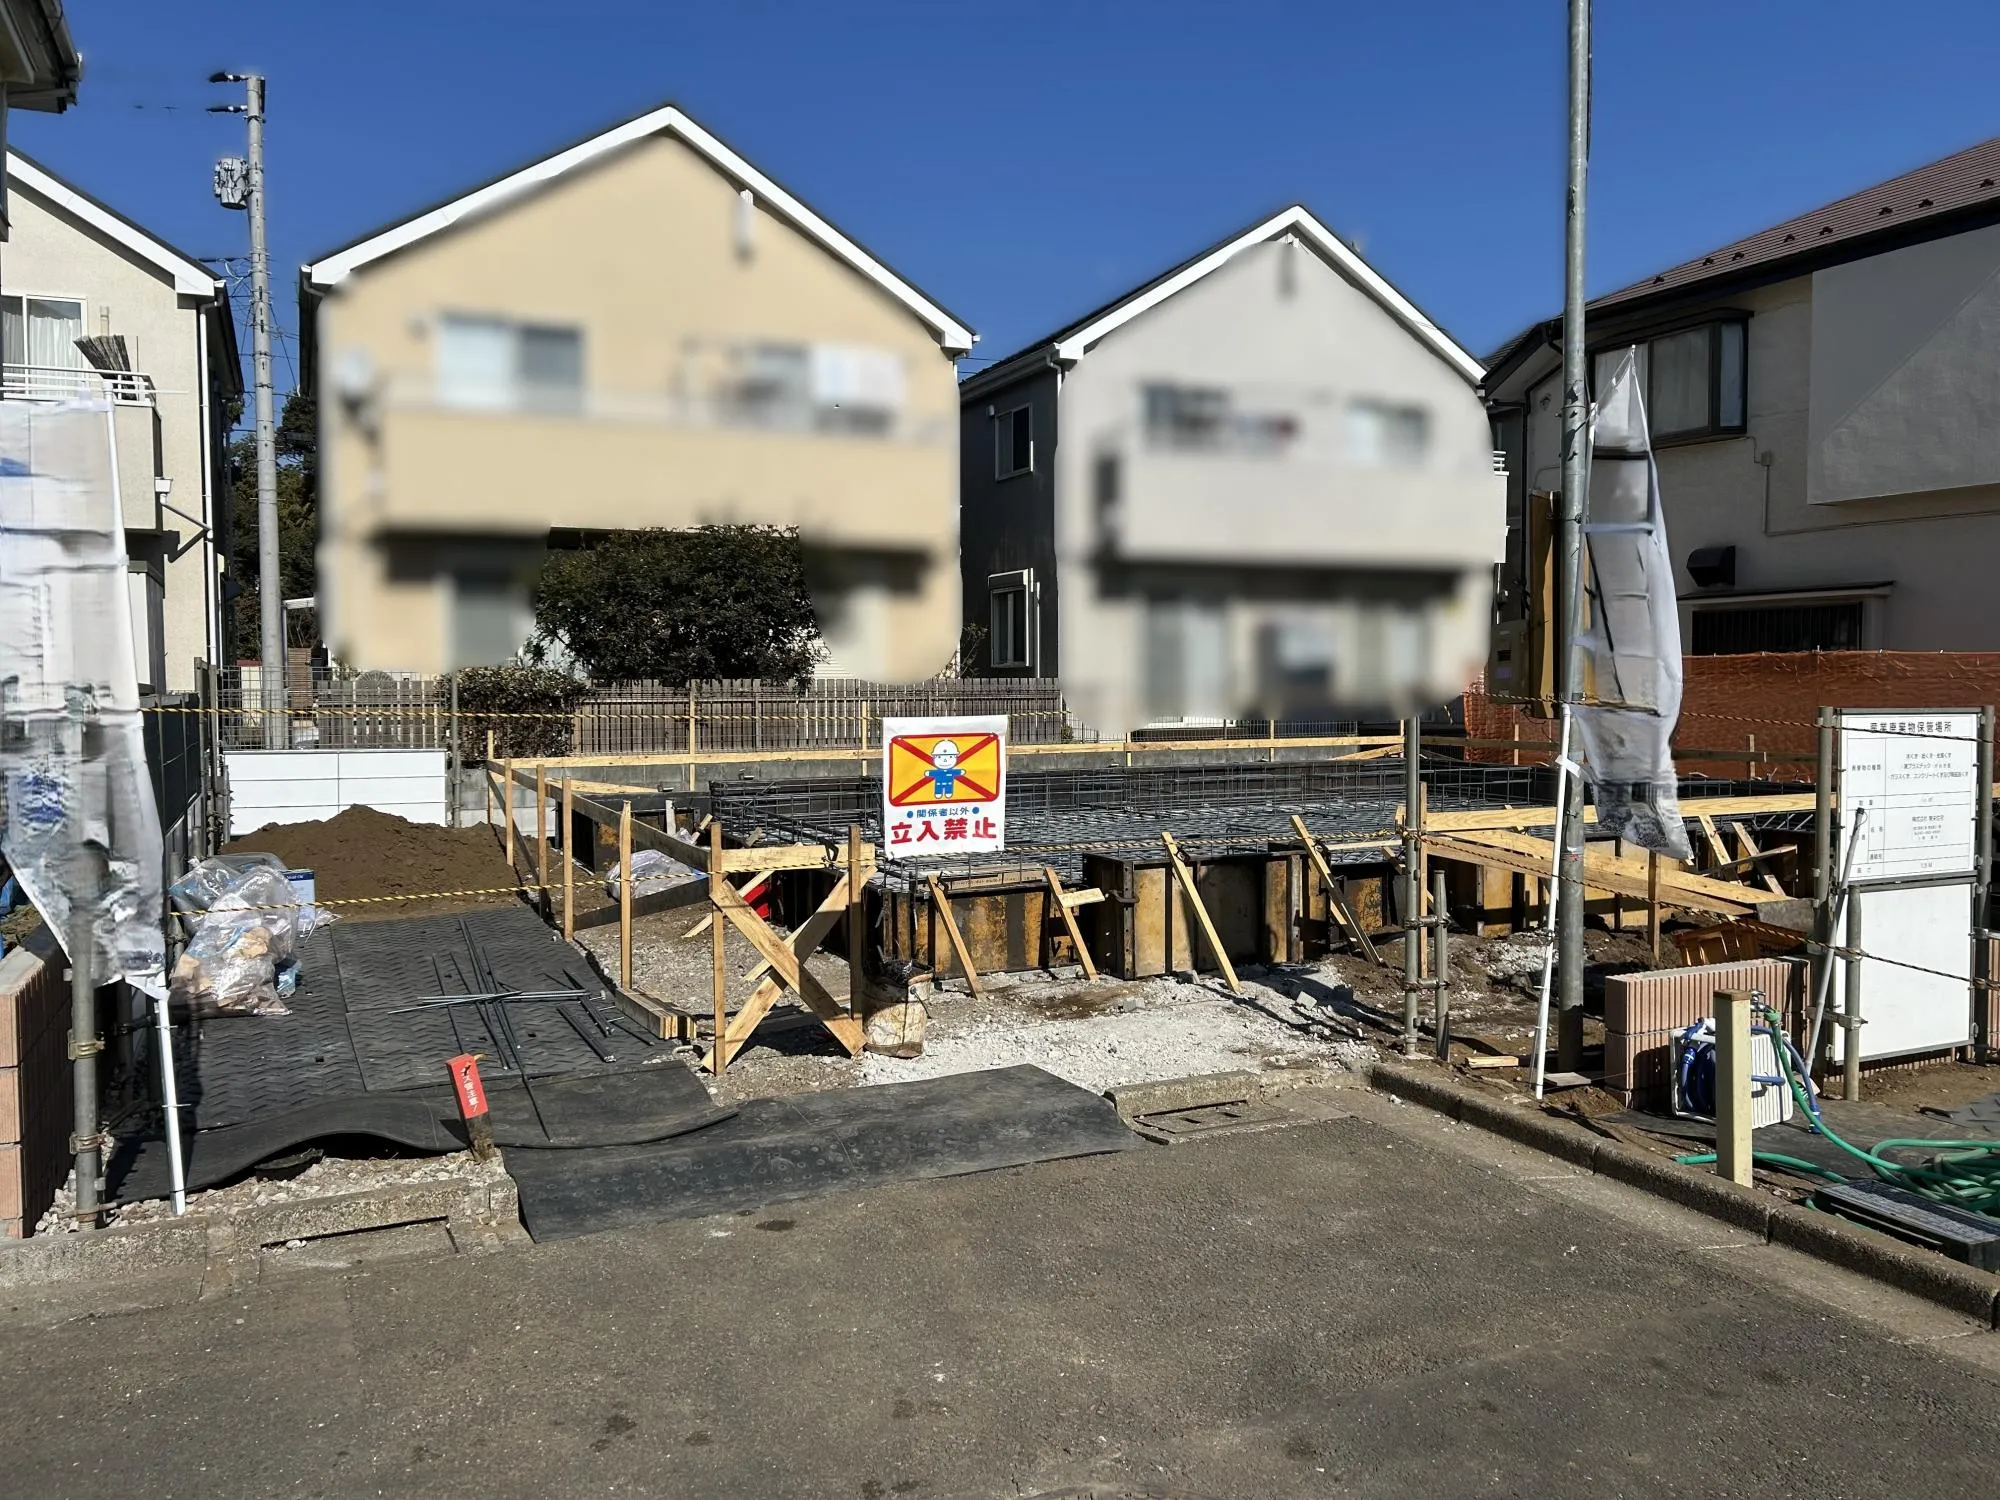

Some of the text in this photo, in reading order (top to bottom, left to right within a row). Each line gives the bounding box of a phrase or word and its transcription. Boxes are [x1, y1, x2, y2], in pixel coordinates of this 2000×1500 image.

[916, 807, 970, 818] 関係者以外
[891, 817, 997, 845] 立入禁止
